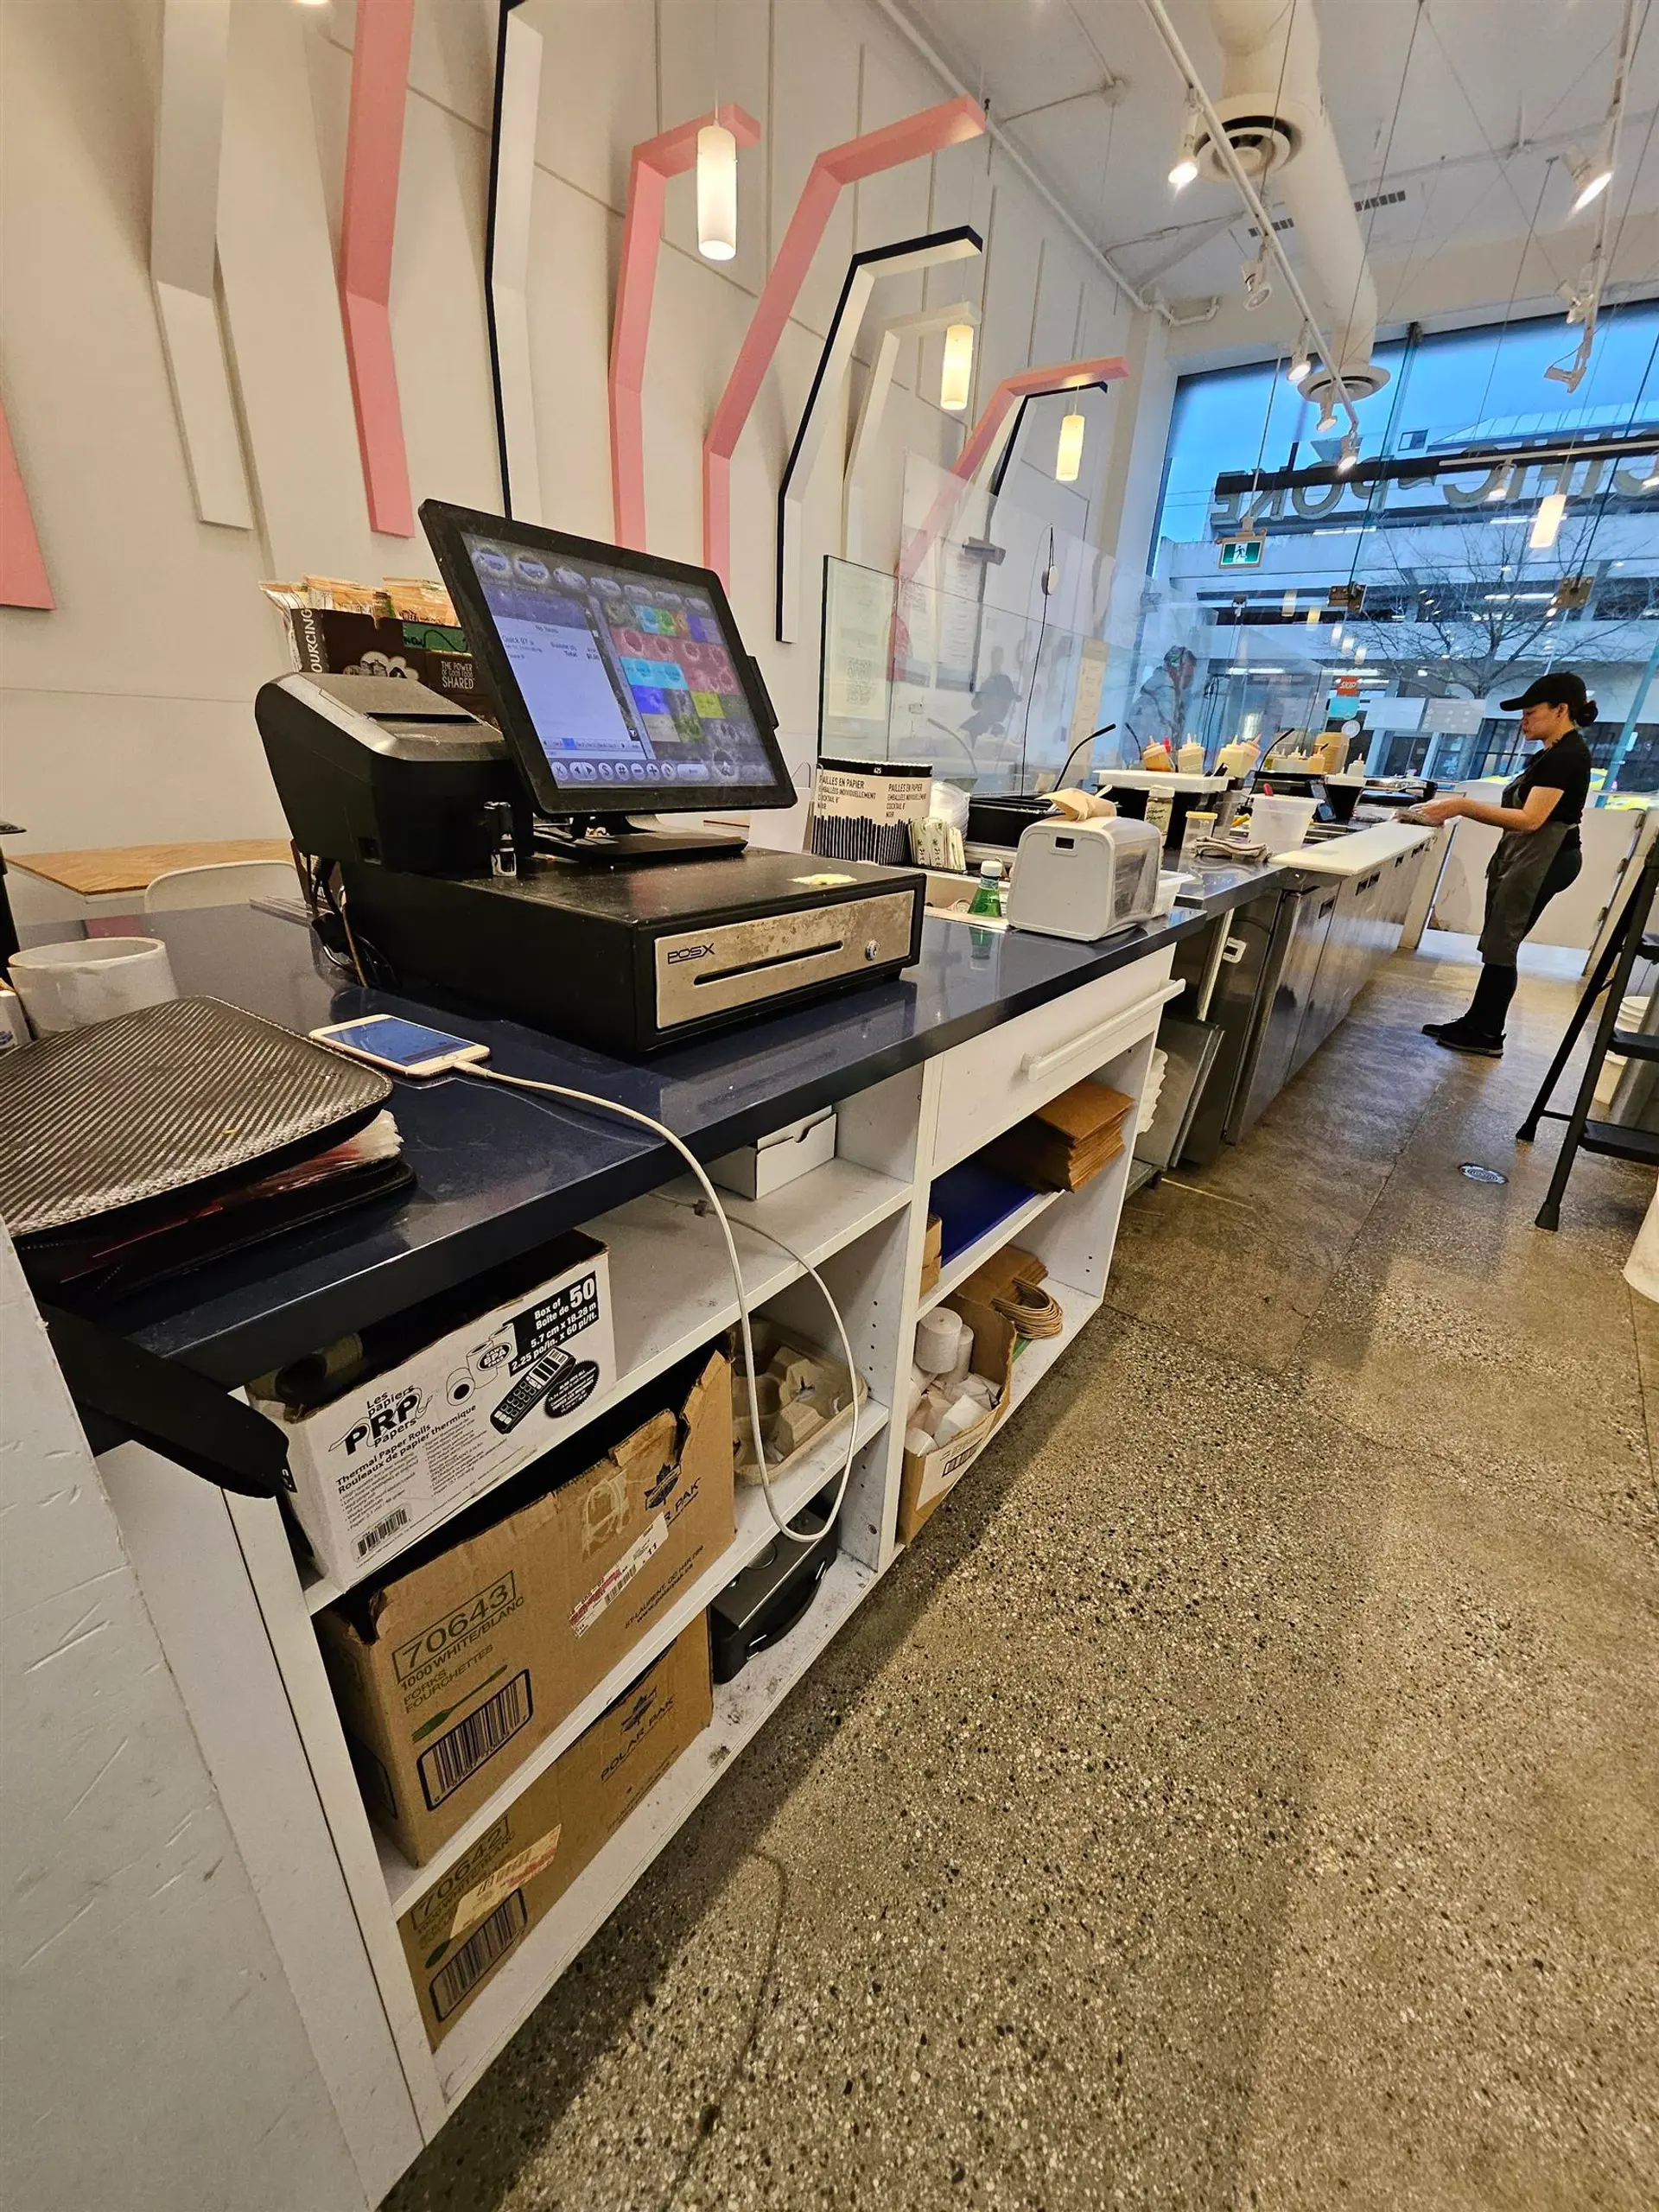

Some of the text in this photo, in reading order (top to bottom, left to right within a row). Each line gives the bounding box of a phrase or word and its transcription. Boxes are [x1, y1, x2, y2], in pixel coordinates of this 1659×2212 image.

[441, 661, 473, 672] THE POWER
[442, 677, 474, 689] SHARED
[846, 779, 865, 789] PAPIER
[534, 1278, 594, 1319] Box of 50
[559, 1306, 569, 1317] de
[531, 1334, 544, 1348] 5.7
[546, 1326, 559, 1338] cm
[567, 1307, 588, 1325] 18.28
[588, 1302, 596, 1312] m
[483, 1350, 507, 1365] BPA
[512, 1353, 532, 1371] 2.25
[533, 1339, 558, 1358] po/in.
[566, 1325, 577, 1335] 60
[366, 1391, 388, 1408] Les
[367, 1385, 415, 1418] papiers
[344, 1394, 418, 1456] PRP
[336, 1424, 431, 1485] Thermal Paper Rolls
[338, 1405, 476, 1494] Rouleaux de papier thermique
[676, 1477, 702, 1511] PAK
[402, 1584, 507, 1669] 70643
[402, 1665, 433, 1690] 1000
[433, 1596, 524, 1668] WHITE/BLANC
[404, 1669, 447, 1705] FORKS
[405, 1644, 493, 1714] FOURCHETTES
[601, 1728, 645, 1781] POLAR
[649, 1694, 675, 1726] PAK
[419, 1827, 501, 1916] 70642
